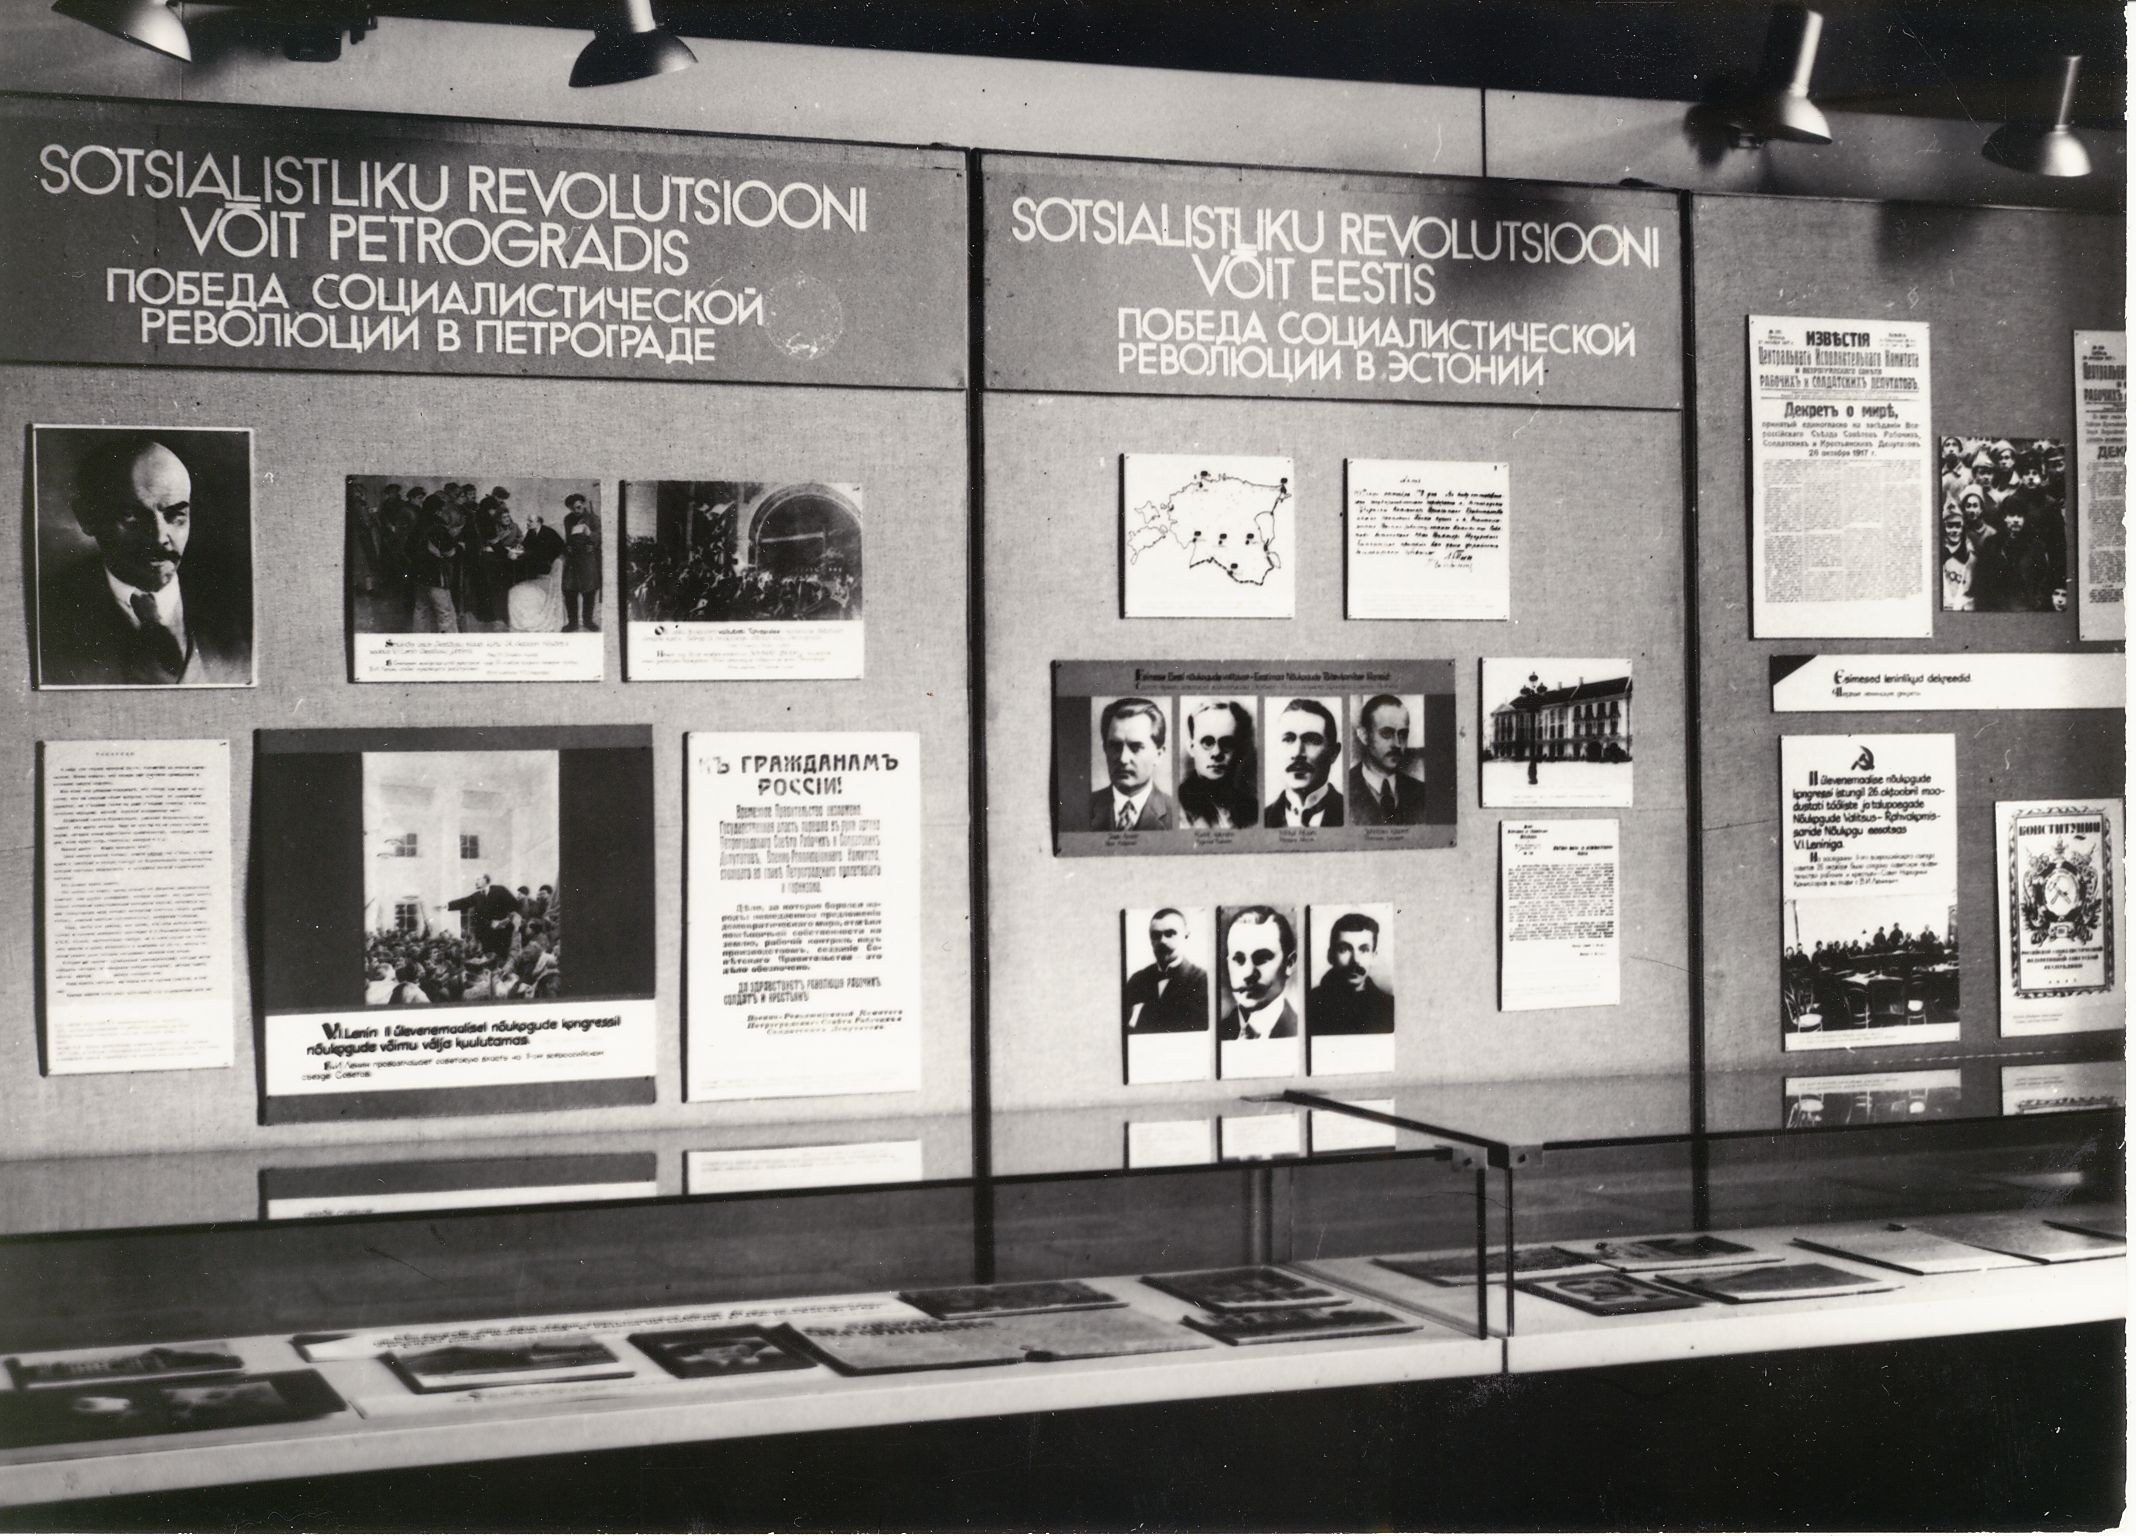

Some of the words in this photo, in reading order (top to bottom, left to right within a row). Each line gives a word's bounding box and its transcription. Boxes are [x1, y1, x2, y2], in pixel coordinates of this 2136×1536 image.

[39, 144, 449, 206] SOTSIALISTLIKU
[468, 164, 868, 233] REVOLUTSIOONI
[180, 201, 305, 259] VÕIT
[330, 218, 690, 277] PETROGRADIS
[1012, 197, 1324, 252] SOTSIALISTLIKU
[1341, 212, 1660, 269] REVOLUTSIOONI
[106, 267, 290, 310] ПОБЕДА
[313, 273, 765, 327] СОЦИАЛИСТИЧЕСКОЙ
[1191, 250, 1291, 300] VÕIT
[1312, 261, 1437, 306] EESTIS
[141, 307, 420, 354] РЕВОЛЮЦИИ
[437, 318, 460, 352] В
[476, 320, 716, 364] ПЕТРОГРАДЕ
[1118, 308, 1267, 344] ПОБЕДА
[1278, 312, 1637, 357] СОЦИАЛИСТИЧЕСКОЙ
[1118, 345, 1342, 383] РЕВОЛЮЦИИ
[1356, 351, 1376, 382] В
[1388, 353, 1546, 387] ЭСТОНИИ
[1784, 402, 1839, 418] Декретъ
[1846, 406, 1855, 417] о
[741, 754, 899, 774] ГРАЖДАНАМЪ
